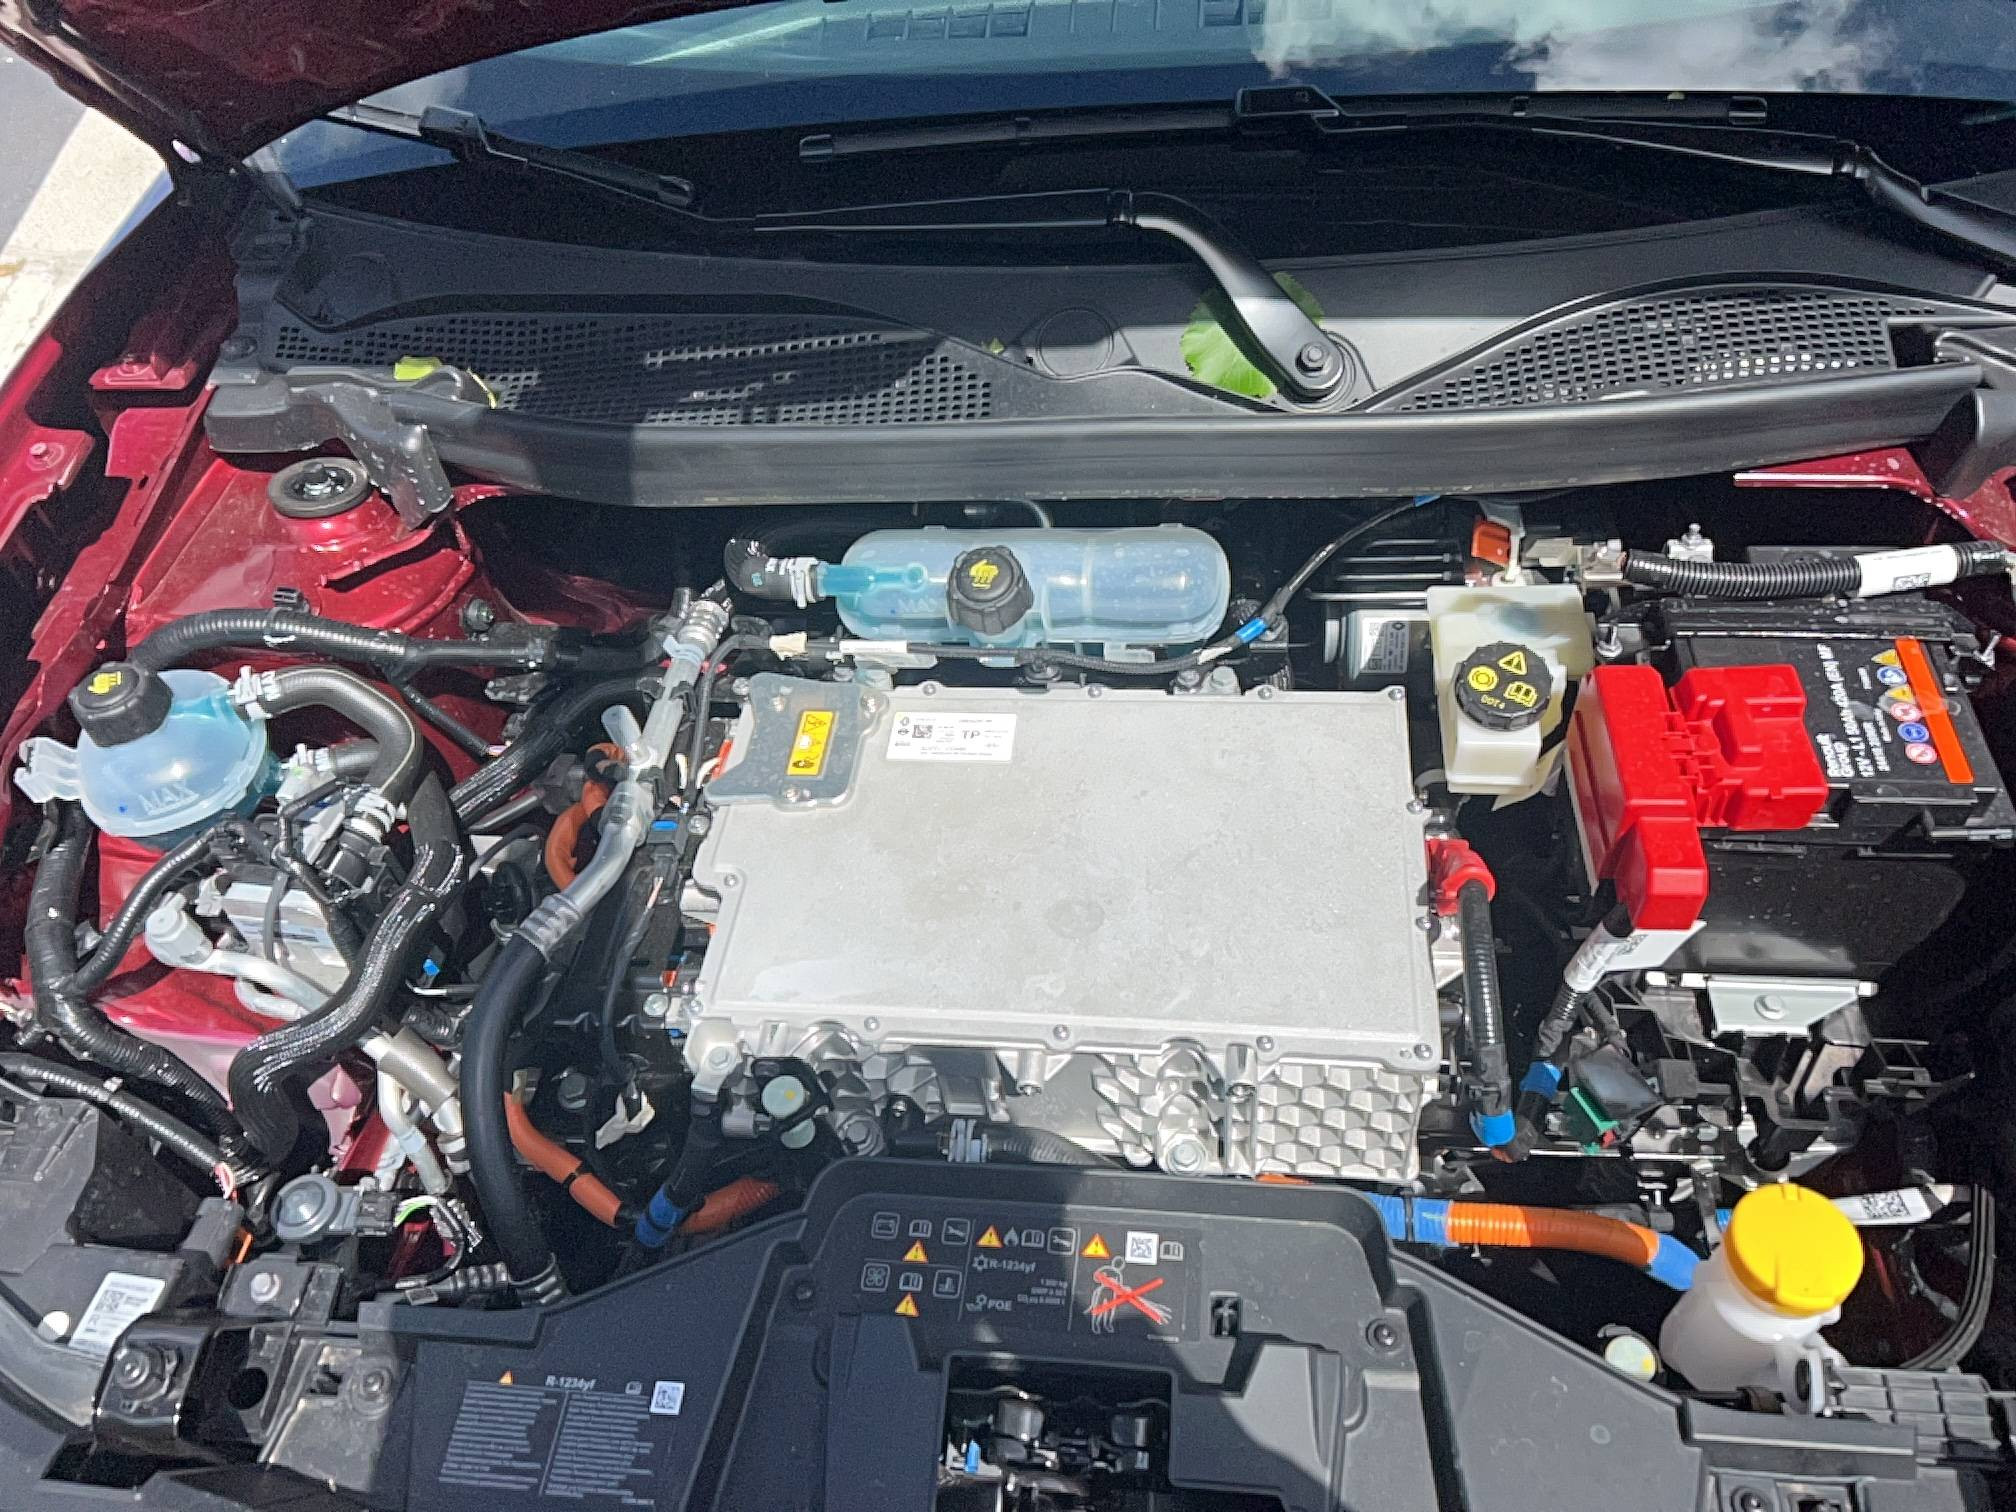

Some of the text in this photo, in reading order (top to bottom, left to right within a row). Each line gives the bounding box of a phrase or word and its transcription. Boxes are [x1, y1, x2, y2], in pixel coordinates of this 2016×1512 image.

[961, 729, 981, 739] TP
[1854, 757, 1875, 777] 12V
[139, 785, 199, 814] MAX
[989, 1259, 1036, 1274] R-1234yf
[988, 1299, 1012, 1311] POE
[545, 1375, 598, 1391] R-1234yf
